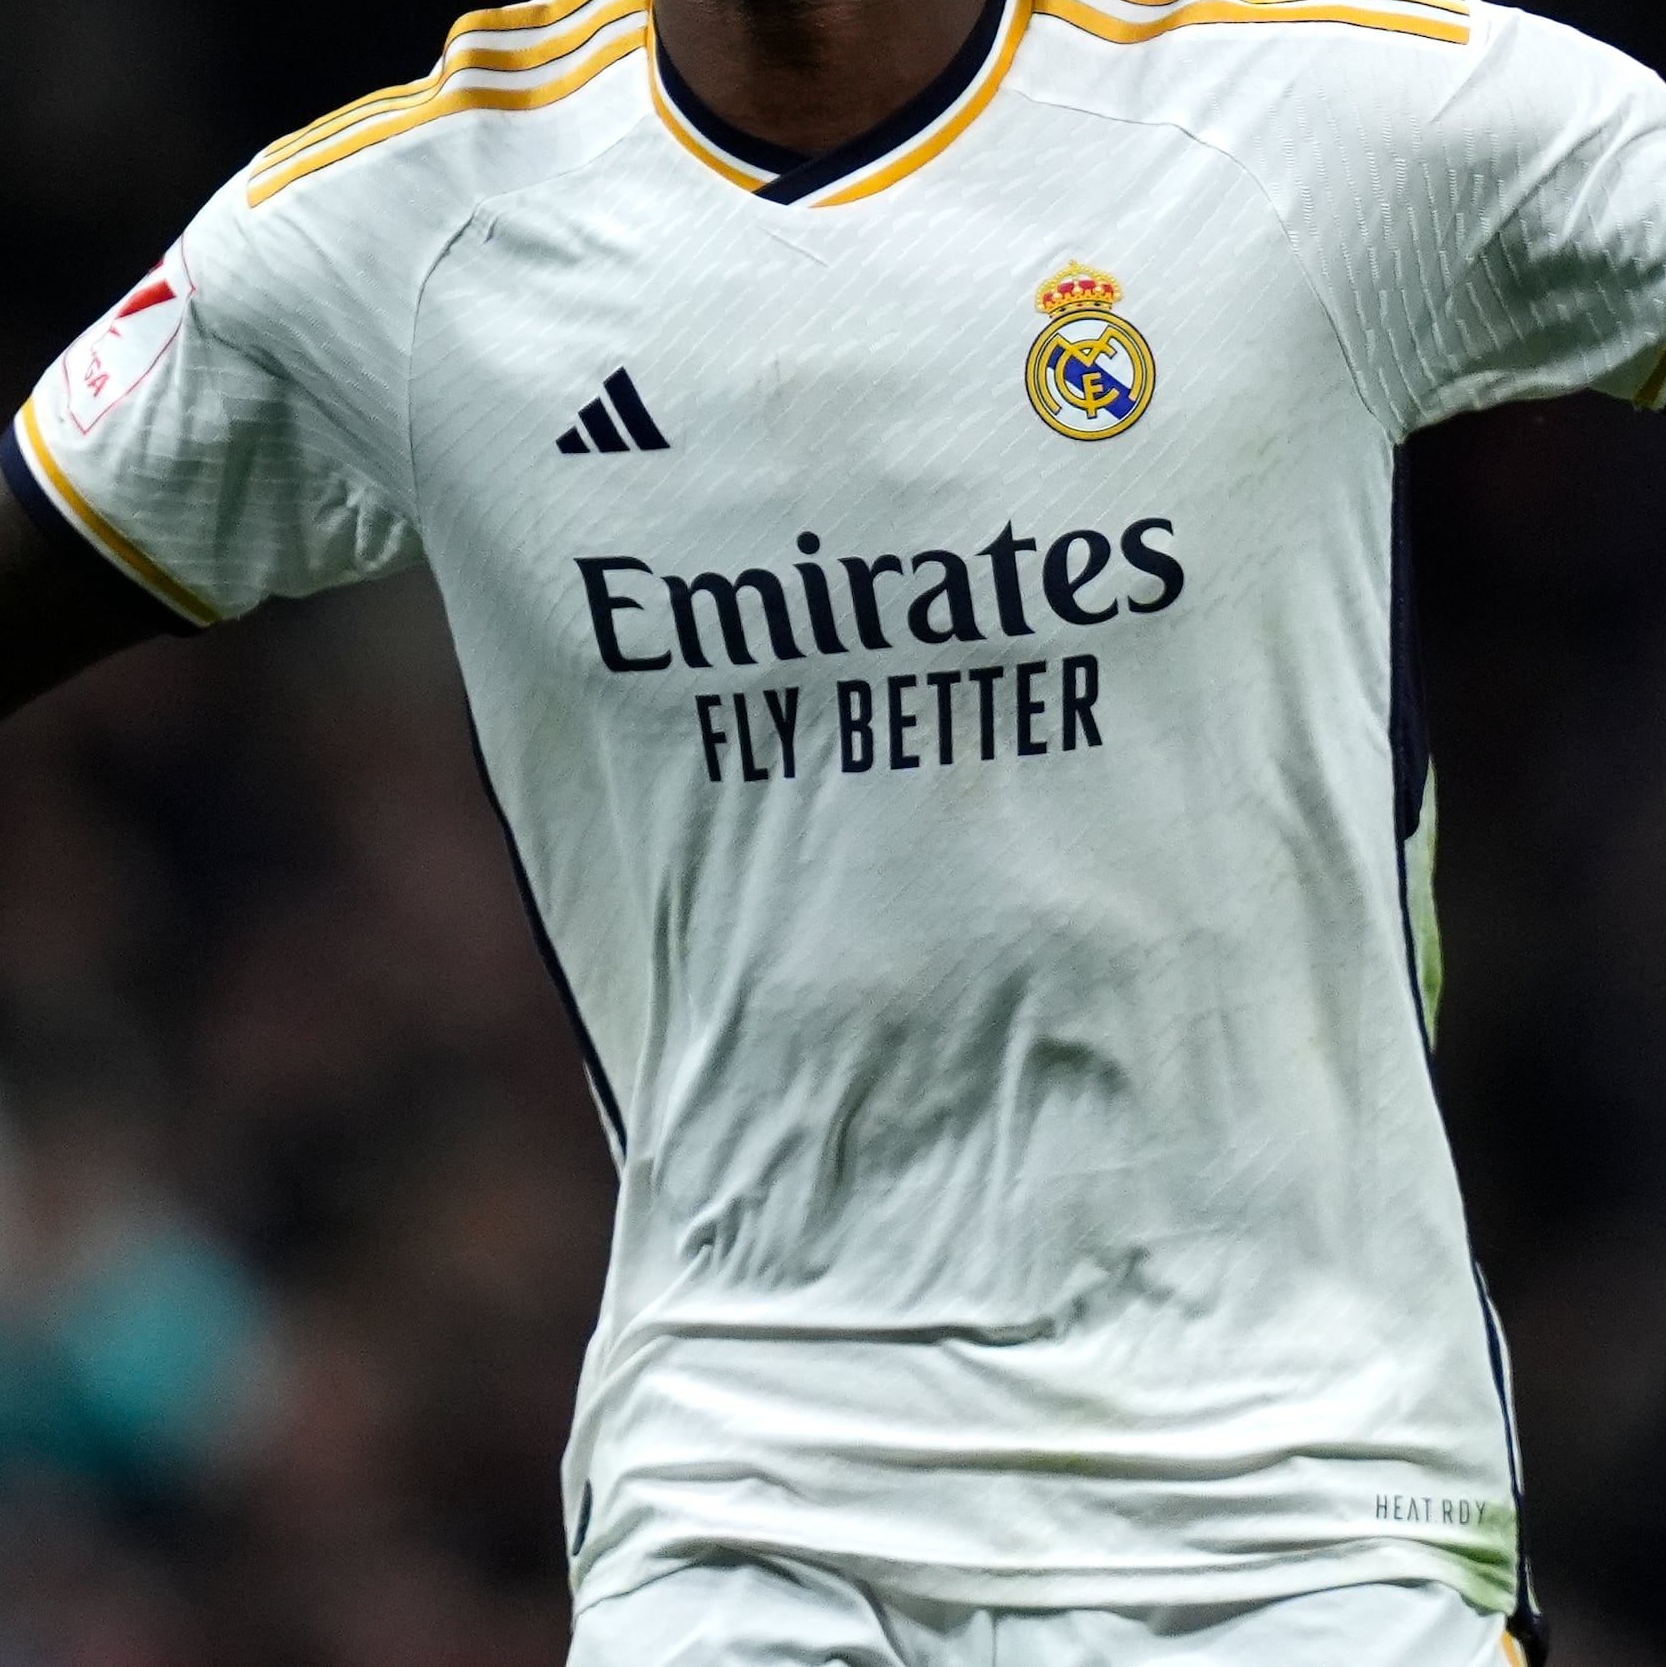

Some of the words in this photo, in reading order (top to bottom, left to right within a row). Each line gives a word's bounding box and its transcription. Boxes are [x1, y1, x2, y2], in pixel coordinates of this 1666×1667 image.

[573, 517, 1185, 674] Emirates
[694, 686, 801, 783] FLY
[836, 653, 1104, 775] BETTER
